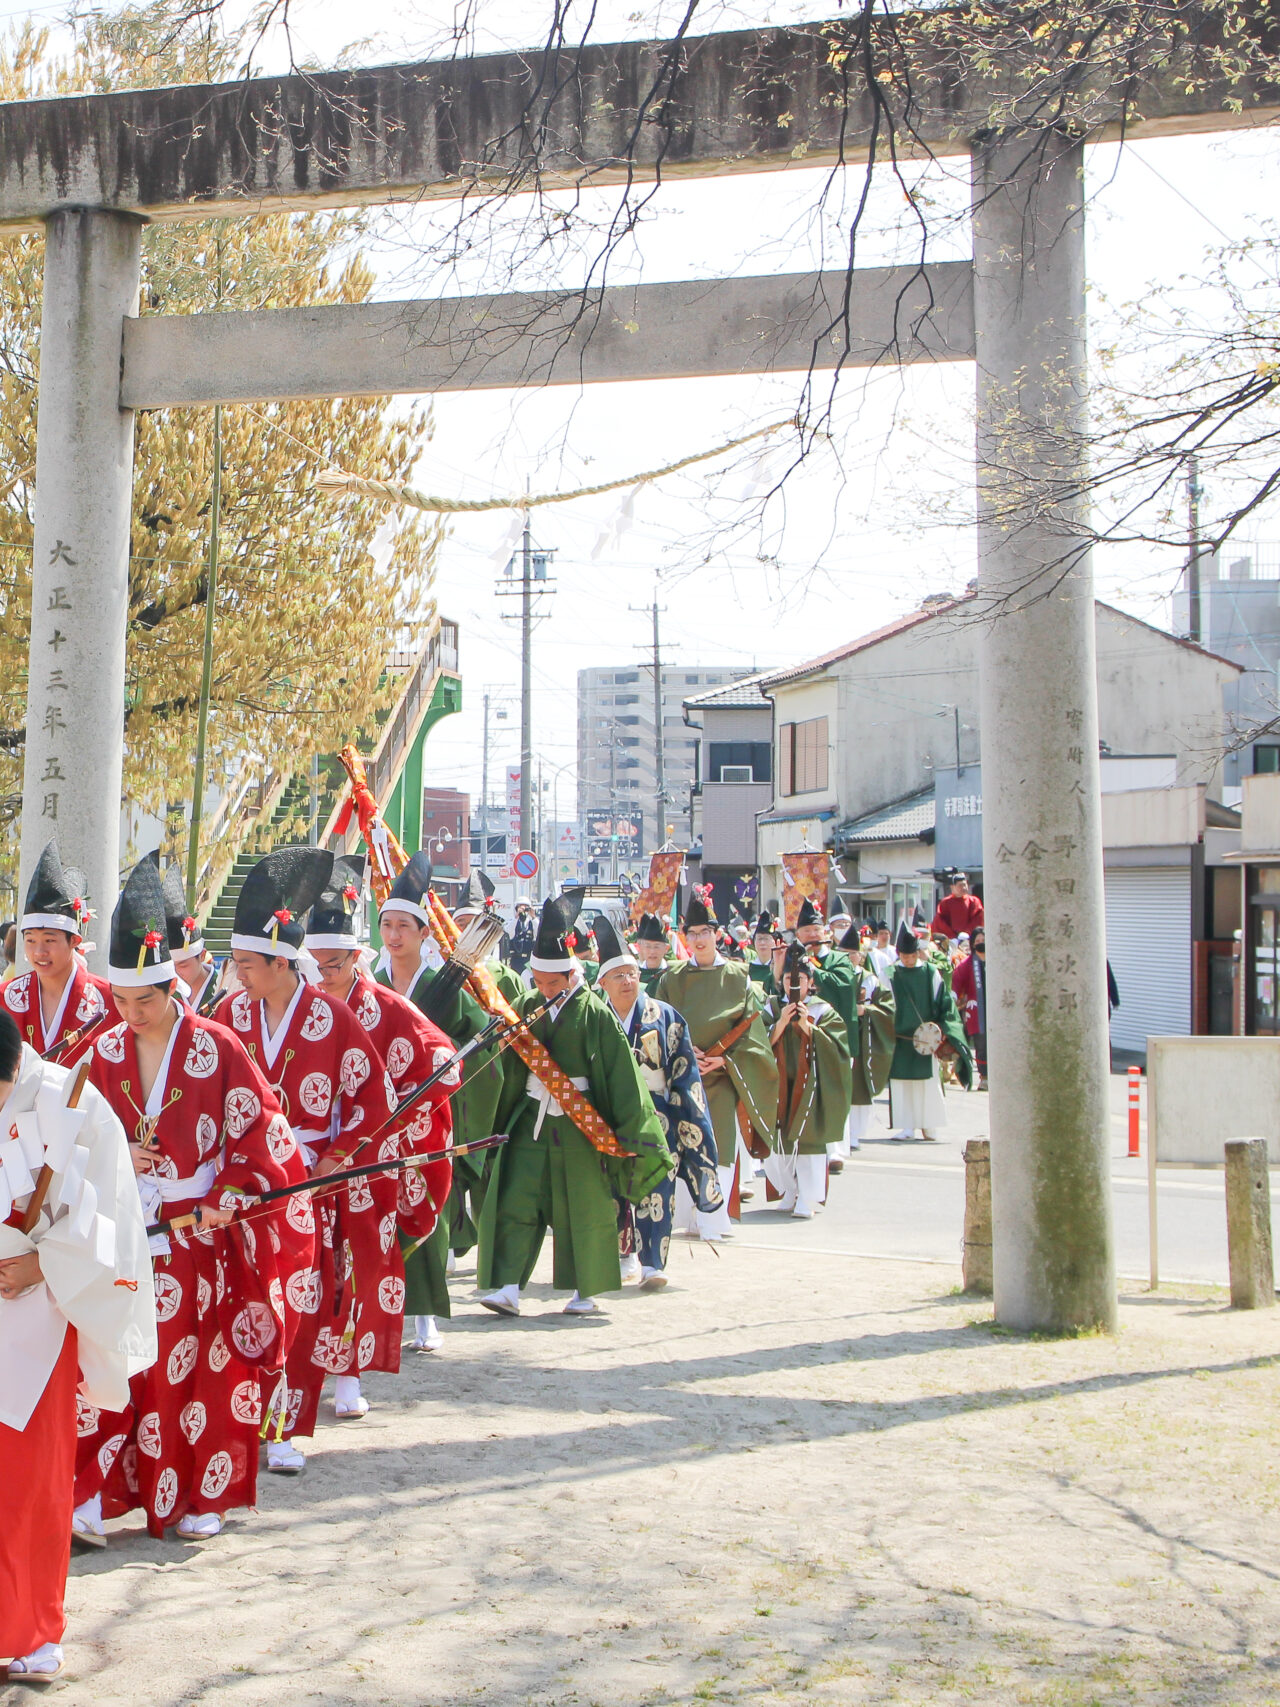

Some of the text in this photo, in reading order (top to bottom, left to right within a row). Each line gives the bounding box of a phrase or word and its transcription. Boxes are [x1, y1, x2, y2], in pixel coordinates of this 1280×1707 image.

[42, 540, 77, 819] 大正十三年五月
